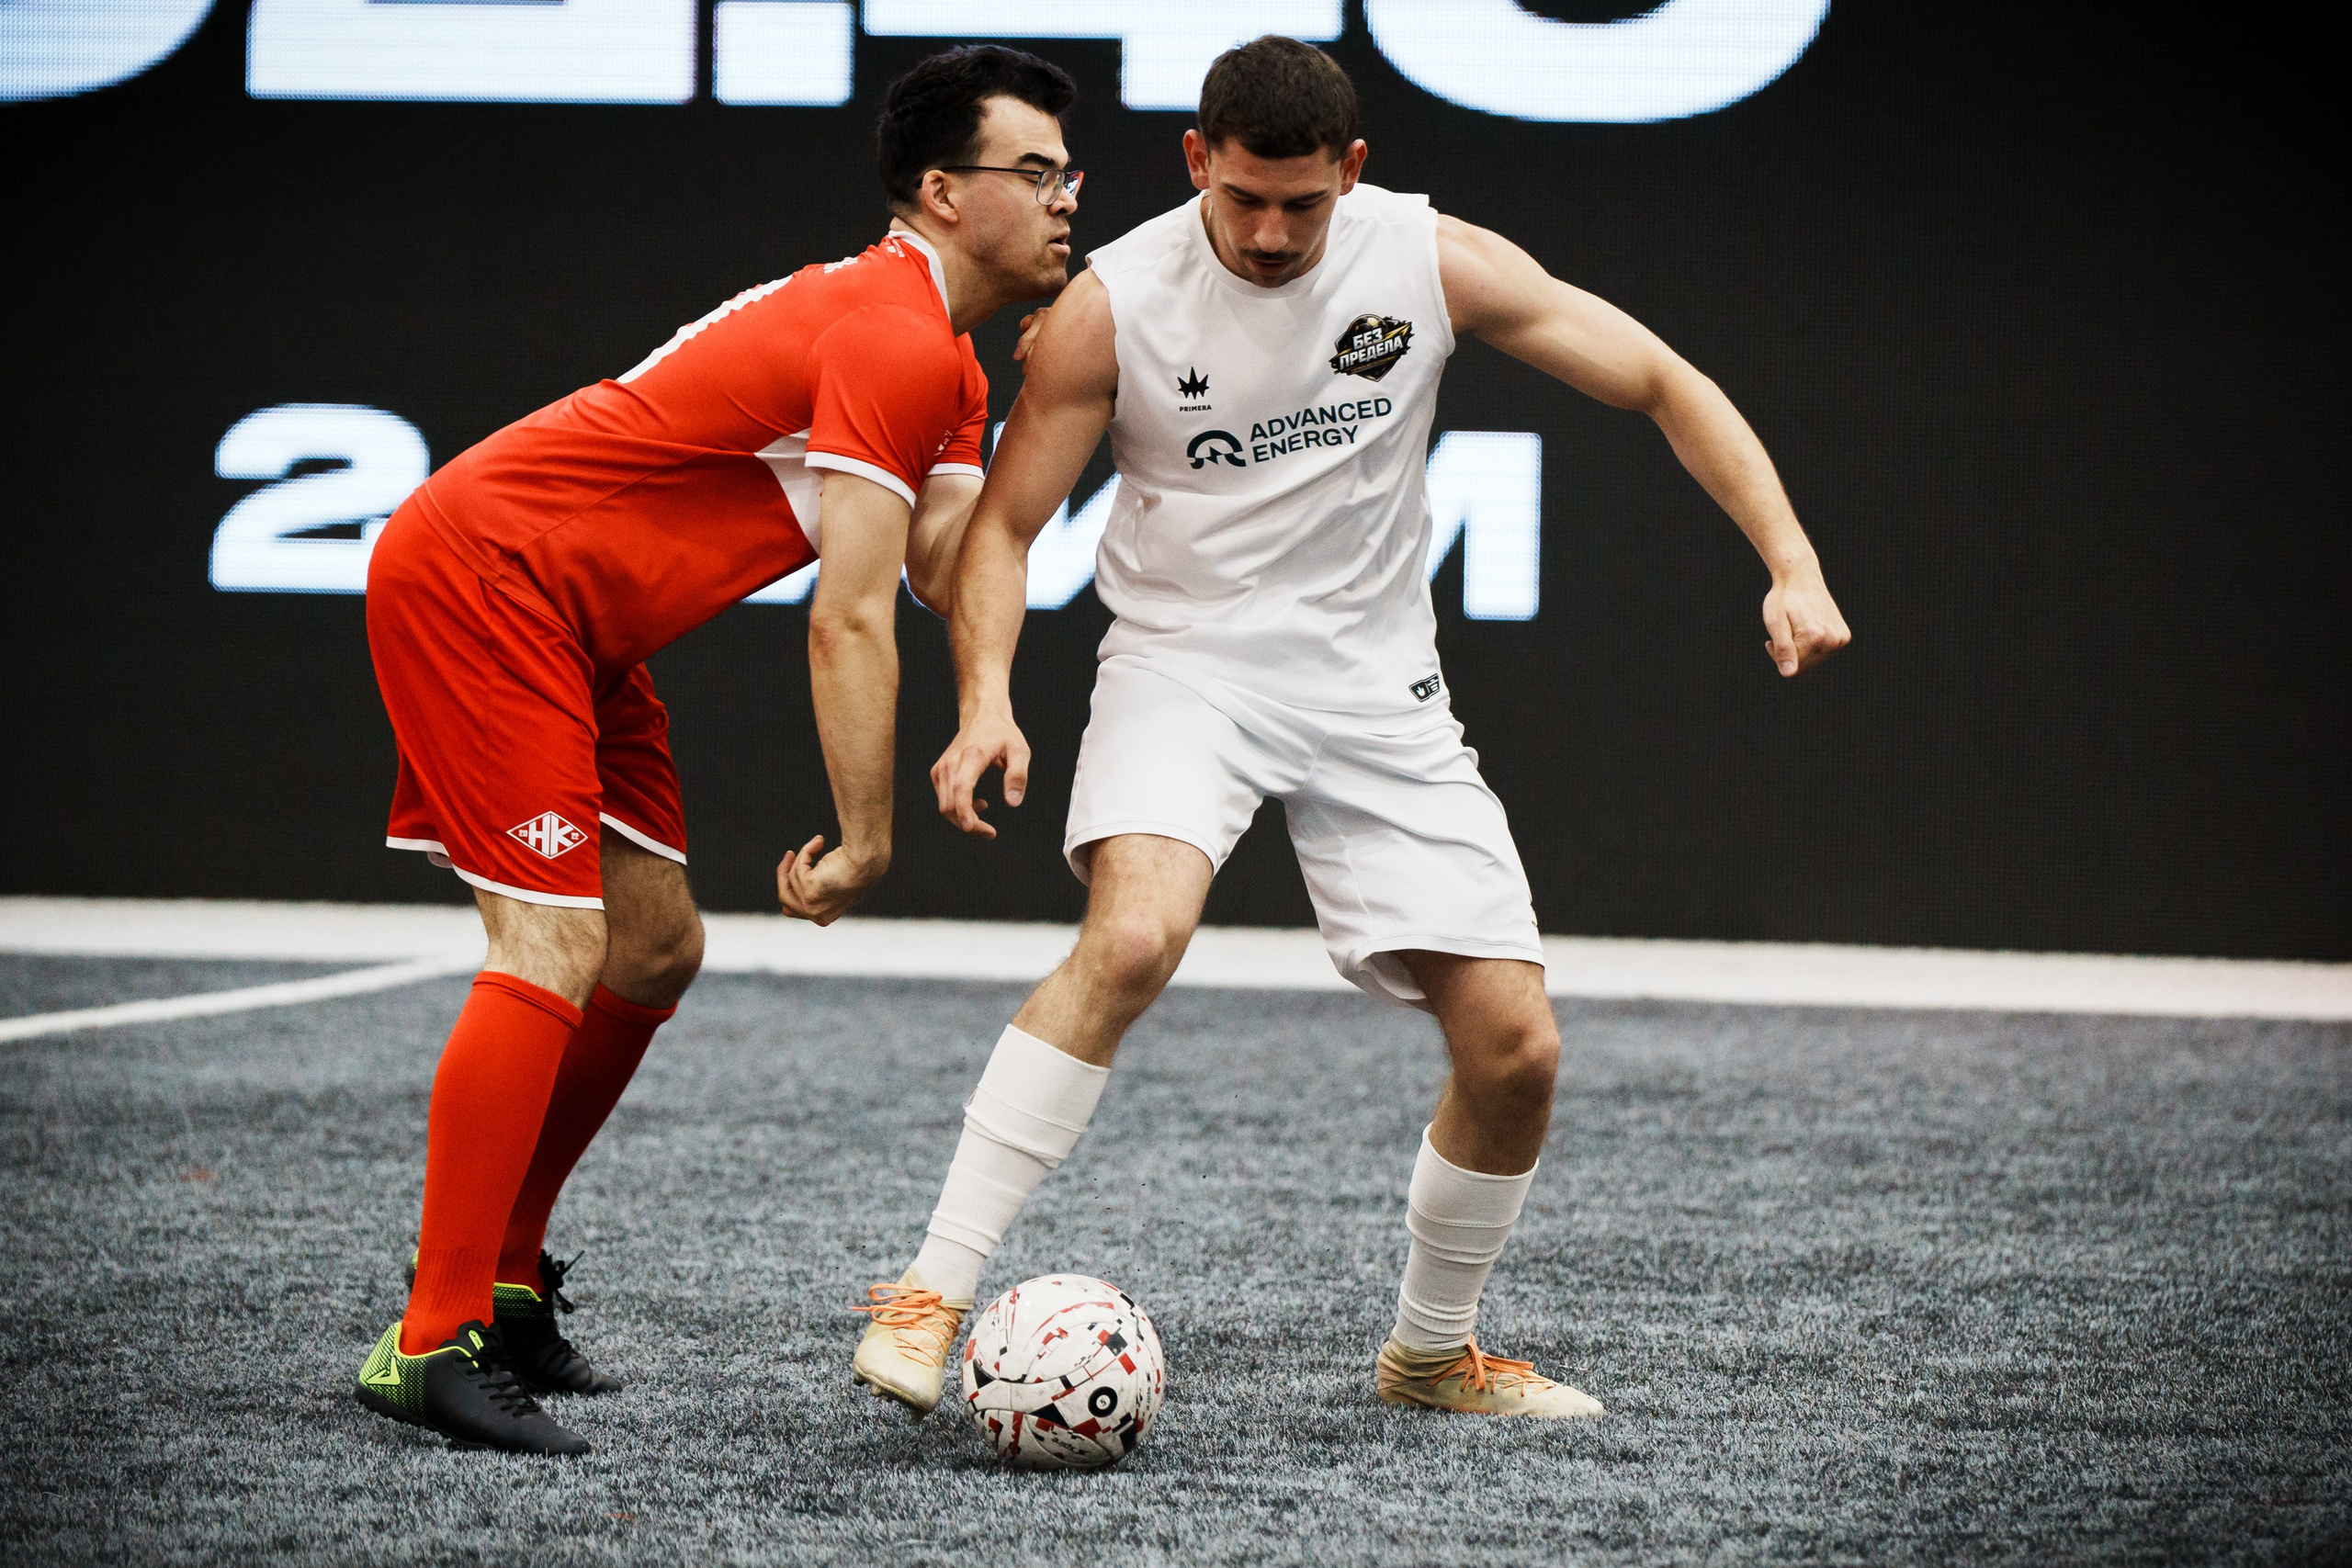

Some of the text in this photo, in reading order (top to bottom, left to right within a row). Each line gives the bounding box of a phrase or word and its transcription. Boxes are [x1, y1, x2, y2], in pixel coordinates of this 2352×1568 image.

[1339, 335, 1404, 370] ПРЕДЕЛА
[1352, 327, 1383, 349] БЕЗ
[1179, 404, 1212, 412] PRIMERA
[1250, 397, 1392, 443] ADVANCED
[1252, 424, 1360, 464] ENERGY
[208, 402, 430, 595] 2
